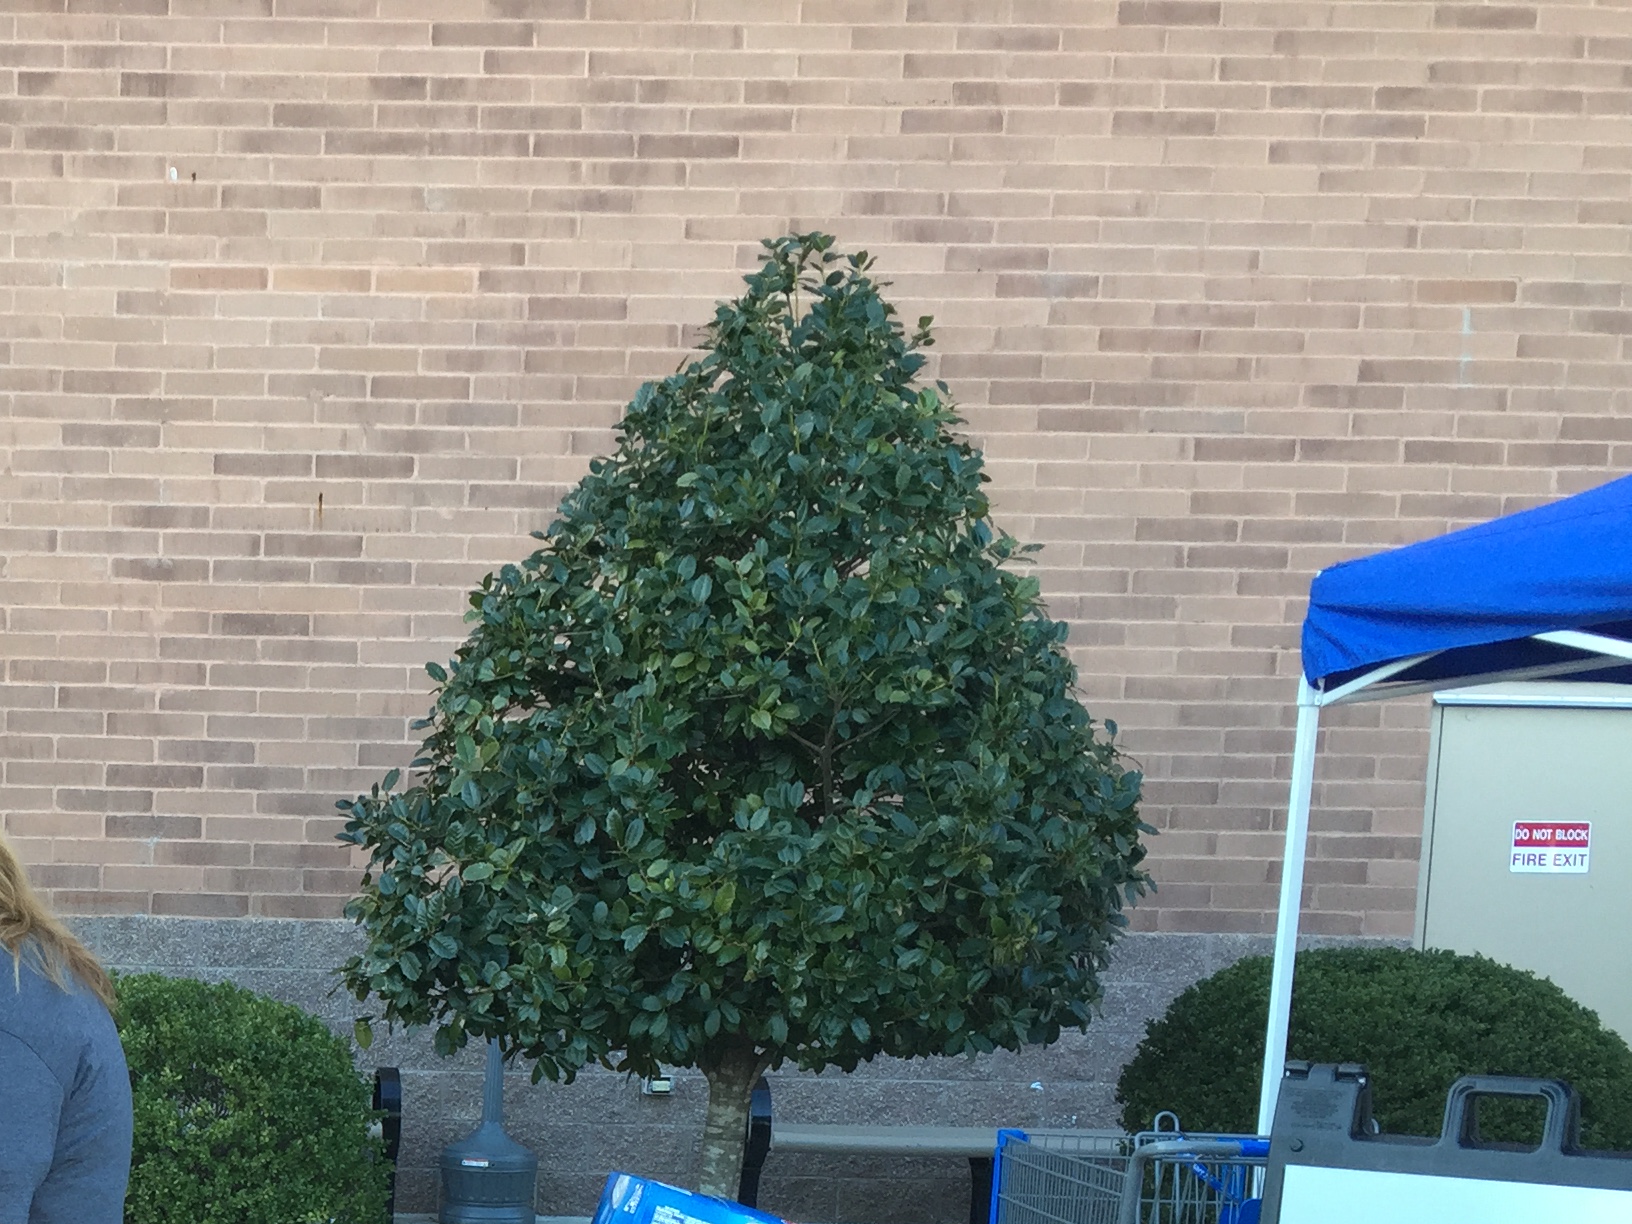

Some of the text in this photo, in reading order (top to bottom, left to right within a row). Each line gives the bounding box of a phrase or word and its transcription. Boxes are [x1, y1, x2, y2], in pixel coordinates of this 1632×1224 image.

[1515, 828, 1589, 841] DO NOT BLOCK
[1512, 852, 1587, 867] FIRE EXIT
